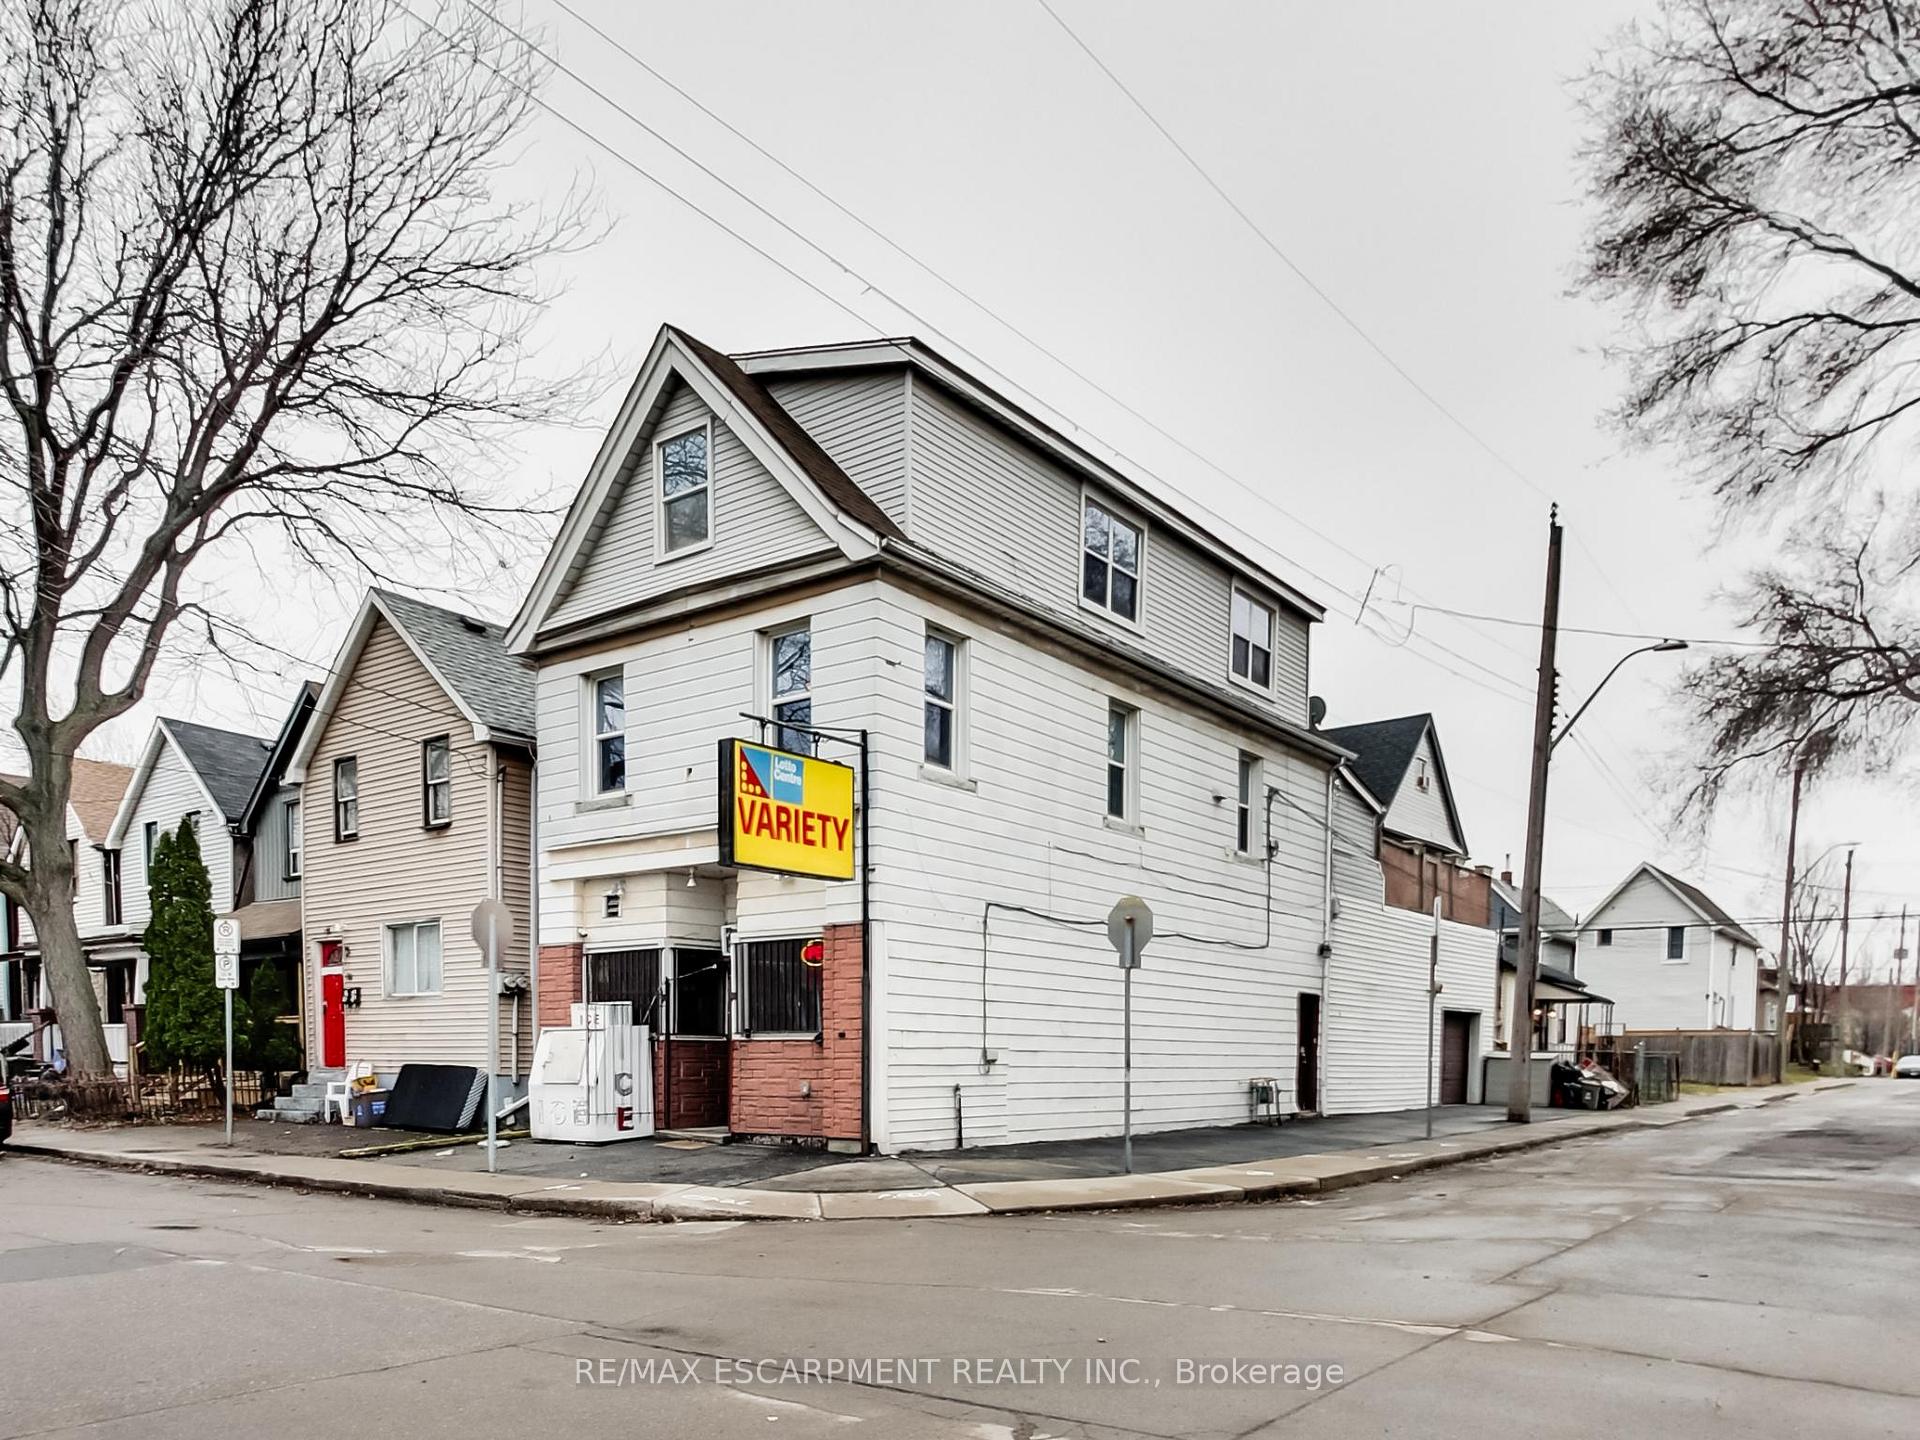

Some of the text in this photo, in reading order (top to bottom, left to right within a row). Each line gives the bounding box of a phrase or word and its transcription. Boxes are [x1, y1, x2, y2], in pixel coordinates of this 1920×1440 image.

[774, 756, 797, 773] Lotto
[774, 769, 802, 786] Centre
[737, 797, 850, 851] VARIETY
